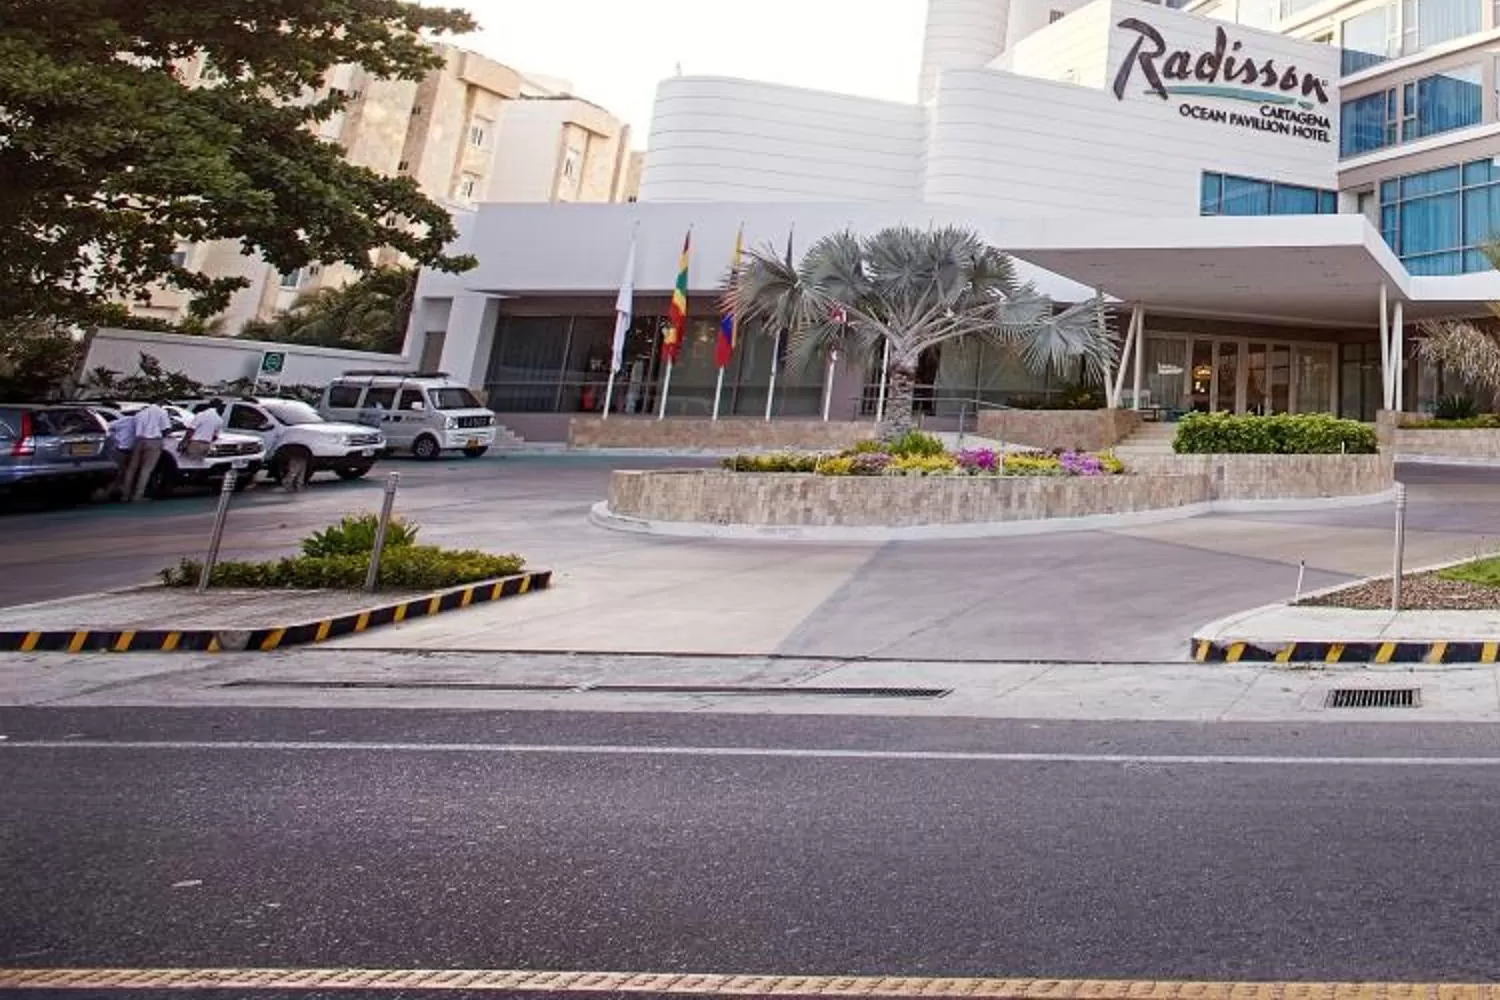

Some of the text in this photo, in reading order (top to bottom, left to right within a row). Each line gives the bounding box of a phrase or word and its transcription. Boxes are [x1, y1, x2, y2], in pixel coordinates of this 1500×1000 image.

[1113, 17, 1328, 102] Radisson
[1179, 104, 1331, 142] OCEAN PAVILLION HOTEL
[1260, 105, 1330, 128] CARTAGENA
